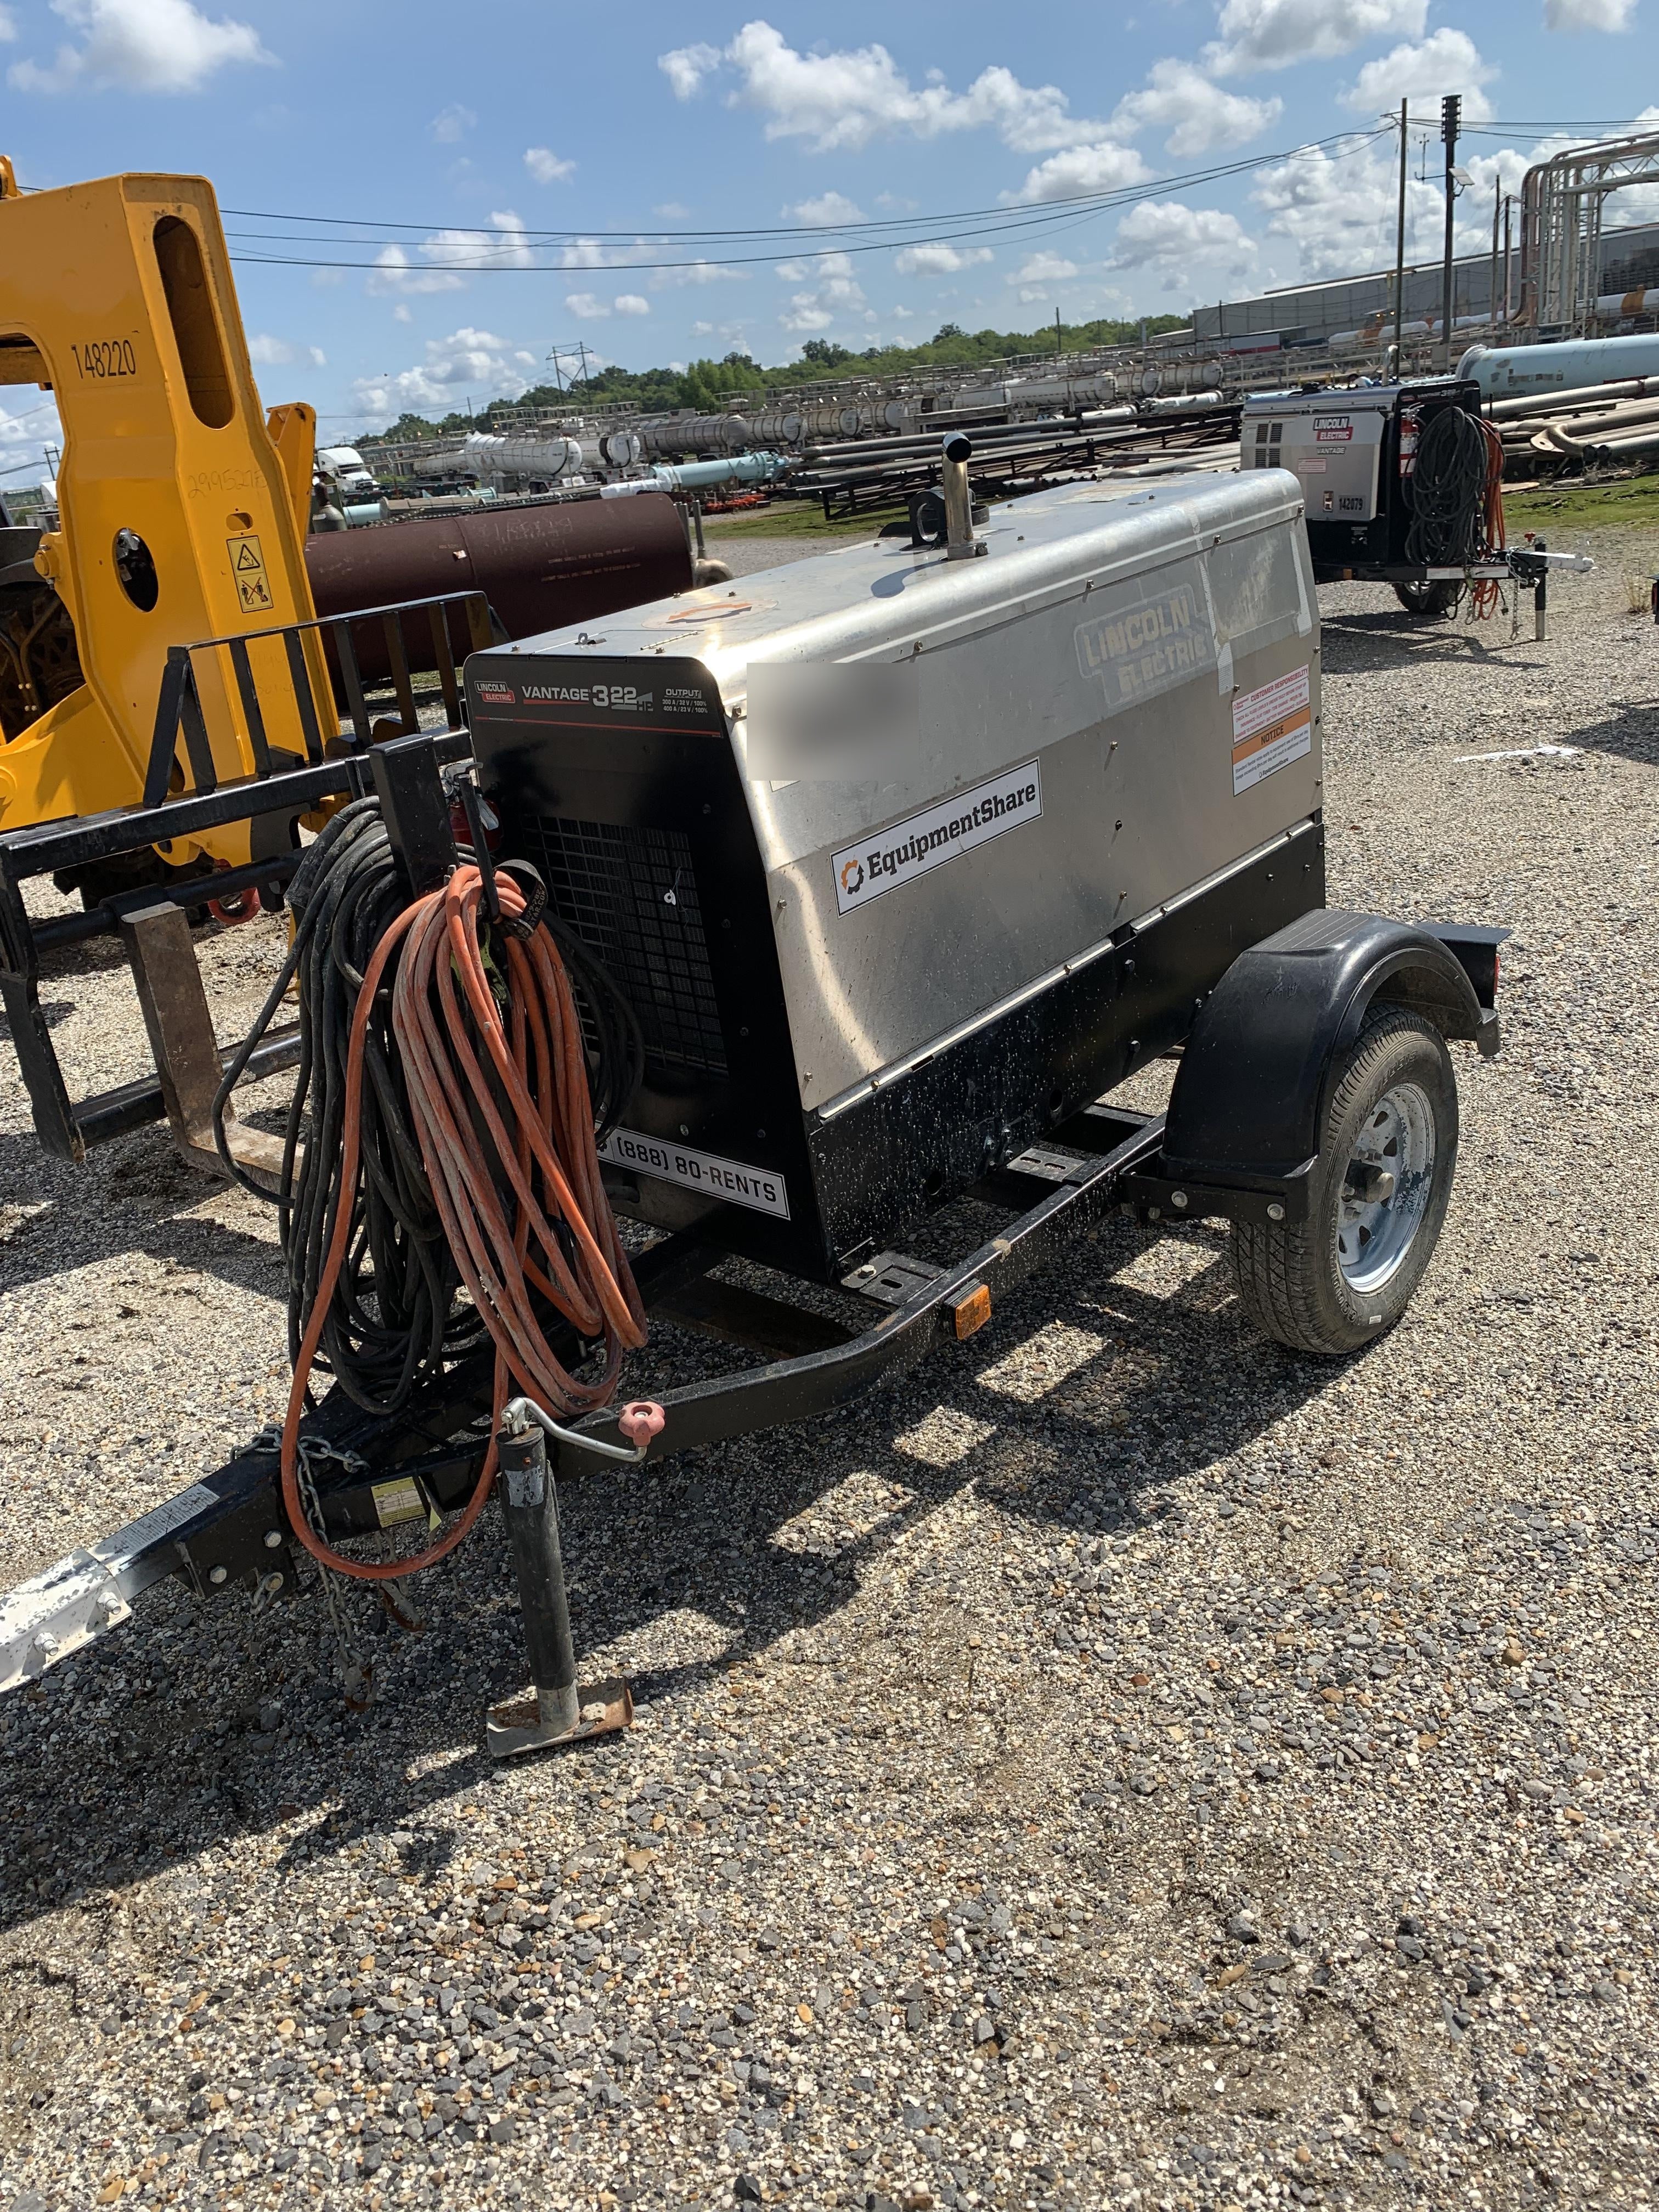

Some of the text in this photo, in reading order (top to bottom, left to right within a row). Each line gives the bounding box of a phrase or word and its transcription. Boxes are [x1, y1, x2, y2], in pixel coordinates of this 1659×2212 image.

[71, 340, 136, 379] 148220
[1314, 418, 1348, 430] LINCOLN
[1320, 431, 1350, 439] ELECTRIC
[1339, 497, 1363, 511] 142079
[1084, 596, 1190, 668] LINCOLN
[1117, 633, 1206, 692] ELECTRIC
[476, 684, 506, 692] LINCOLN
[522, 686, 589, 701] VANTAGE
[592, 685, 637, 707] 322
[1251, 668, 1308, 702] CUSTOMER RESPONSIBILITY
[1261, 725, 1284, 745] NOTICE
[867, 783, 1035, 879] EquipmentShare
[617, 1136, 777, 1203] (888) 80-RENTS
